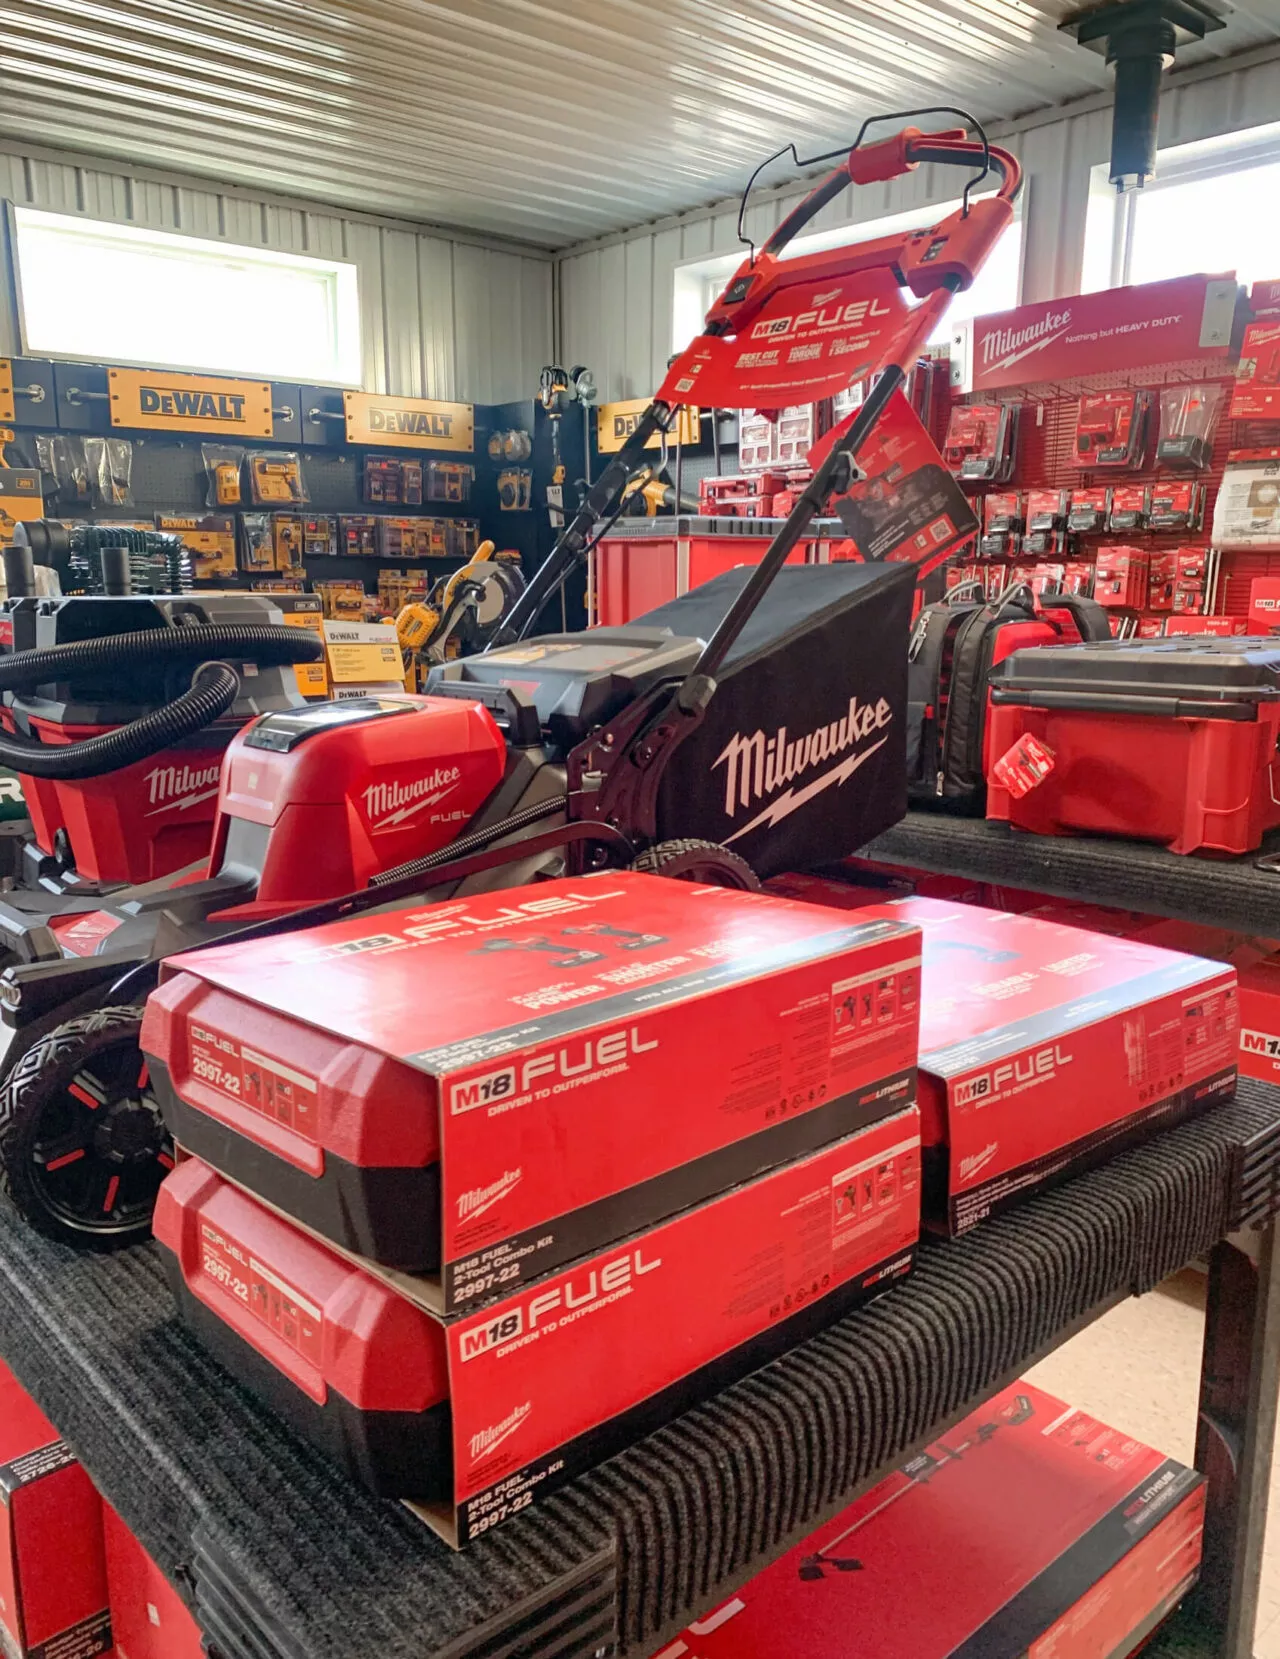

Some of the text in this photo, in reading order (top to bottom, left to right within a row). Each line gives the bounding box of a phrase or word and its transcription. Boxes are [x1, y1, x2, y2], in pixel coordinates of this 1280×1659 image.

[753, 299, 890, 337] M18 FUEL
[979, 309, 1072, 364] Milwaukee
[1065, 331, 1098, 344] Nothing
[1100, 328, 1114, 338] but
[1115, 321, 1149, 334] HEAVY
[140, 389, 245, 419] DEWALT
[369, 410, 453, 436] DEWALT
[710, 696, 893, 818] Milwaukee
[143, 764, 221, 804] Milwa
[361, 766, 460, 820] Milwaukee
[430, 810, 472, 824] FUEL
[403, 890, 626, 938] FUEL
[206, 1033, 240, 1058] FUEL
[1242, 1031, 1280, 1057] M1
[193, 1057, 241, 1095] 2997-22
[453, 1027, 659, 1112] M18 FUEL
[957, 1045, 1073, 1105] M18 FUEL
[488, 1094, 532, 1117] DRIVEN
[535, 1088, 550, 1100] TO
[456, 1166, 523, 1219] Milwaukee
[204, 1255, 249, 1302] 2997-22
[454, 1244, 513, 1276] M18 FUEL
[454, 1235, 554, 1285] 2-Tool Combo Kit
[454, 1263, 520, 1304] 2997-22
[462, 1249, 662, 1360] M18 FUEL
[496, 1331, 539, 1358] DRIVEN
[541, 1322, 558, 1335] TO
[467, 1400, 532, 1458] Milwaukee
[468, 1495, 504, 1522] 2-Tool
[506, 1471, 547, 1499] Combo
[548, 1459, 564, 1475] Kit
[468, 1474, 525, 1512] M18 FUEL
[469, 1491, 533, 1540] 2997-22
